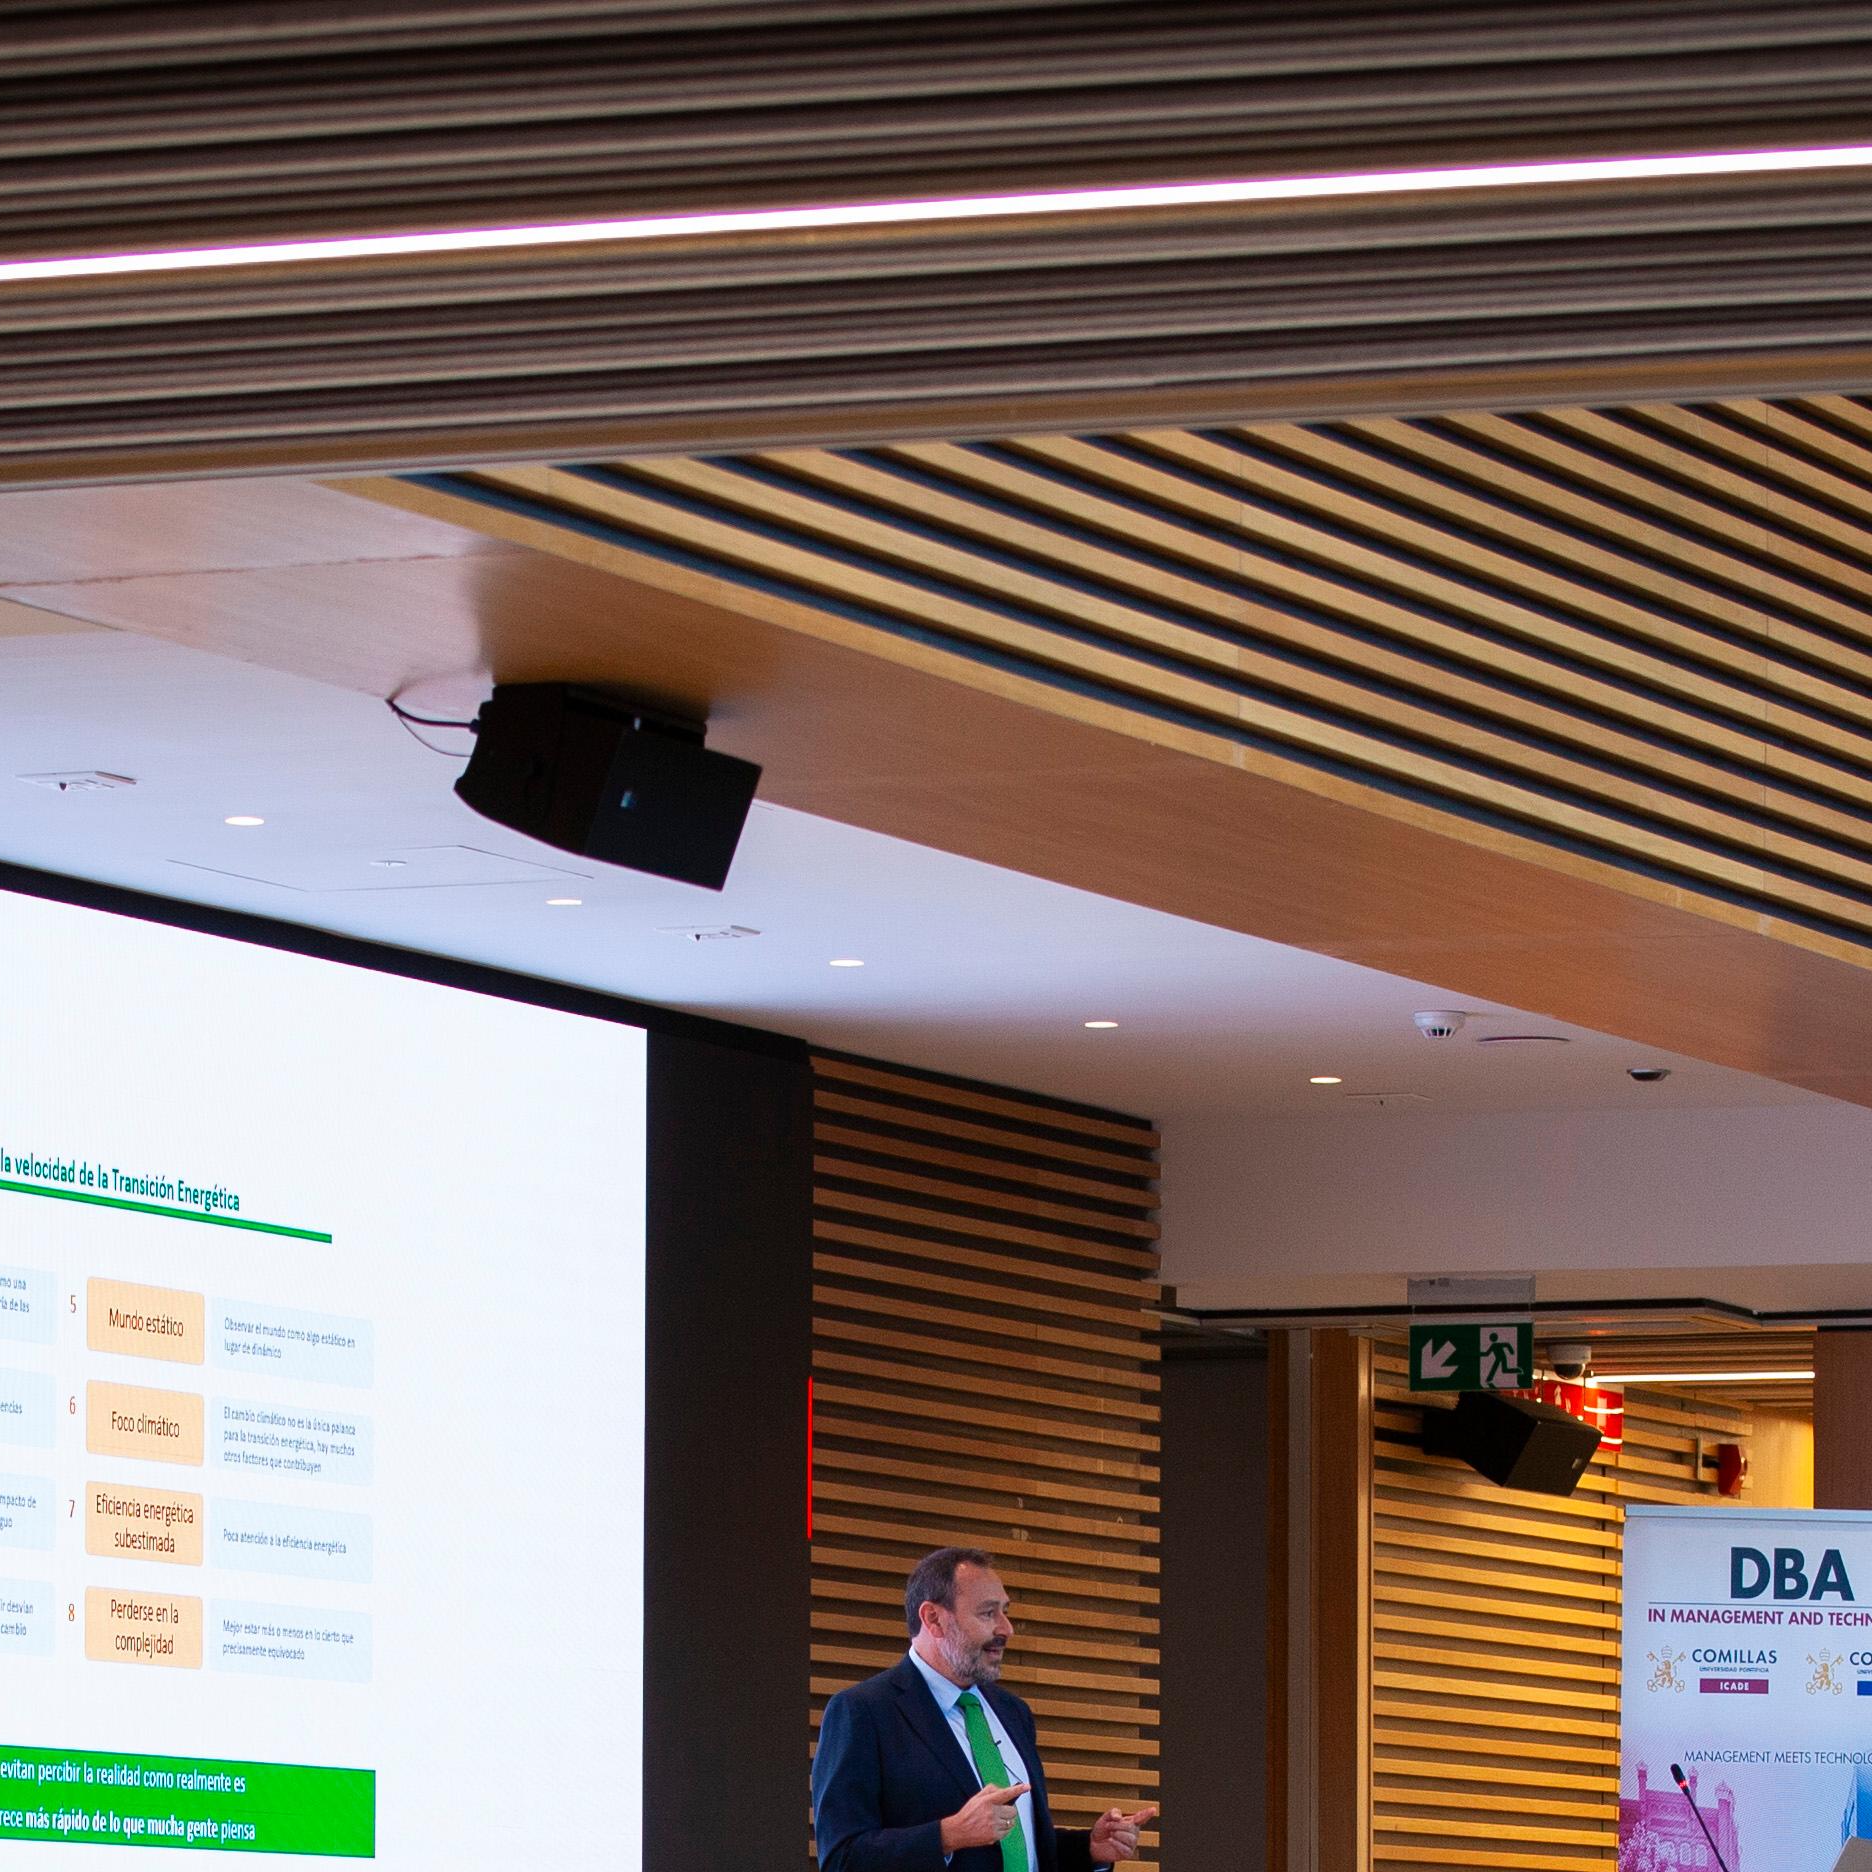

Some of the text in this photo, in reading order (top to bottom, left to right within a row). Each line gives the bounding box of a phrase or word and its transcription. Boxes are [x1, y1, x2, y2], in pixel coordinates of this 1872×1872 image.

[0, 1146, 11, 1173] la
[14, 1152, 75, 1183] velocidad
[78, 1160, 94, 1187] de
[97, 1163, 109, 1189] la
[111, 1167, 174, 1200] Transición
[177, 1178, 240, 1212] Energética
[69, 1293, 77, 1314] 5
[108, 1307, 184, 1337] Mundo estático
[68, 1395, 76, 1415] 6
[111, 1410, 180, 1438] Foco climático
[68, 1498, 75, 1518] 7
[95, 1492, 194, 1527] Eficiencia energética
[113, 1526, 175, 1553] subestimada
[1729, 1545, 1855, 1602] DBA
[67, 1602, 75, 1622] 8
[110, 1598, 179, 1624] Perderse en la
[1647, 1607, 1666, 1623] IN
[1669, 1608, 1784, 1625] MANAGEMENT
[1787, 1610, 1824, 1626] AND
[114, 1631, 174, 1658] complejidad
[1691, 1648, 1777, 1664] COMILLAS
[1719, 1681, 1749, 1691] ICADE
[1683, 1749, 1771, 1763] MANAGEMENT
[1773, 1750, 1811, 1764] MEETS
[0, 1758, 35, 1779] evitan
[37, 1759, 81, 1785] percibir
[82, 1761, 94, 1783] la
[95, 1763, 141, 1786] realidad
[142, 1770, 174, 1788] como
[175, 1768, 231, 1792] realmente
[232, 1776, 246, 1793] es
[25, 1806, 50, 1829] más
[51, 1807, 90, 1835] rápido
[91, 1809, 107, 1832] de
[108, 1809, 121, 1833] lo
[122, 1816, 145, 1839] que
[146, 1813, 185, 1836] mucha
[186, 1817, 219, 1842] gente
[220, 1822, 255, 1843] piensa
